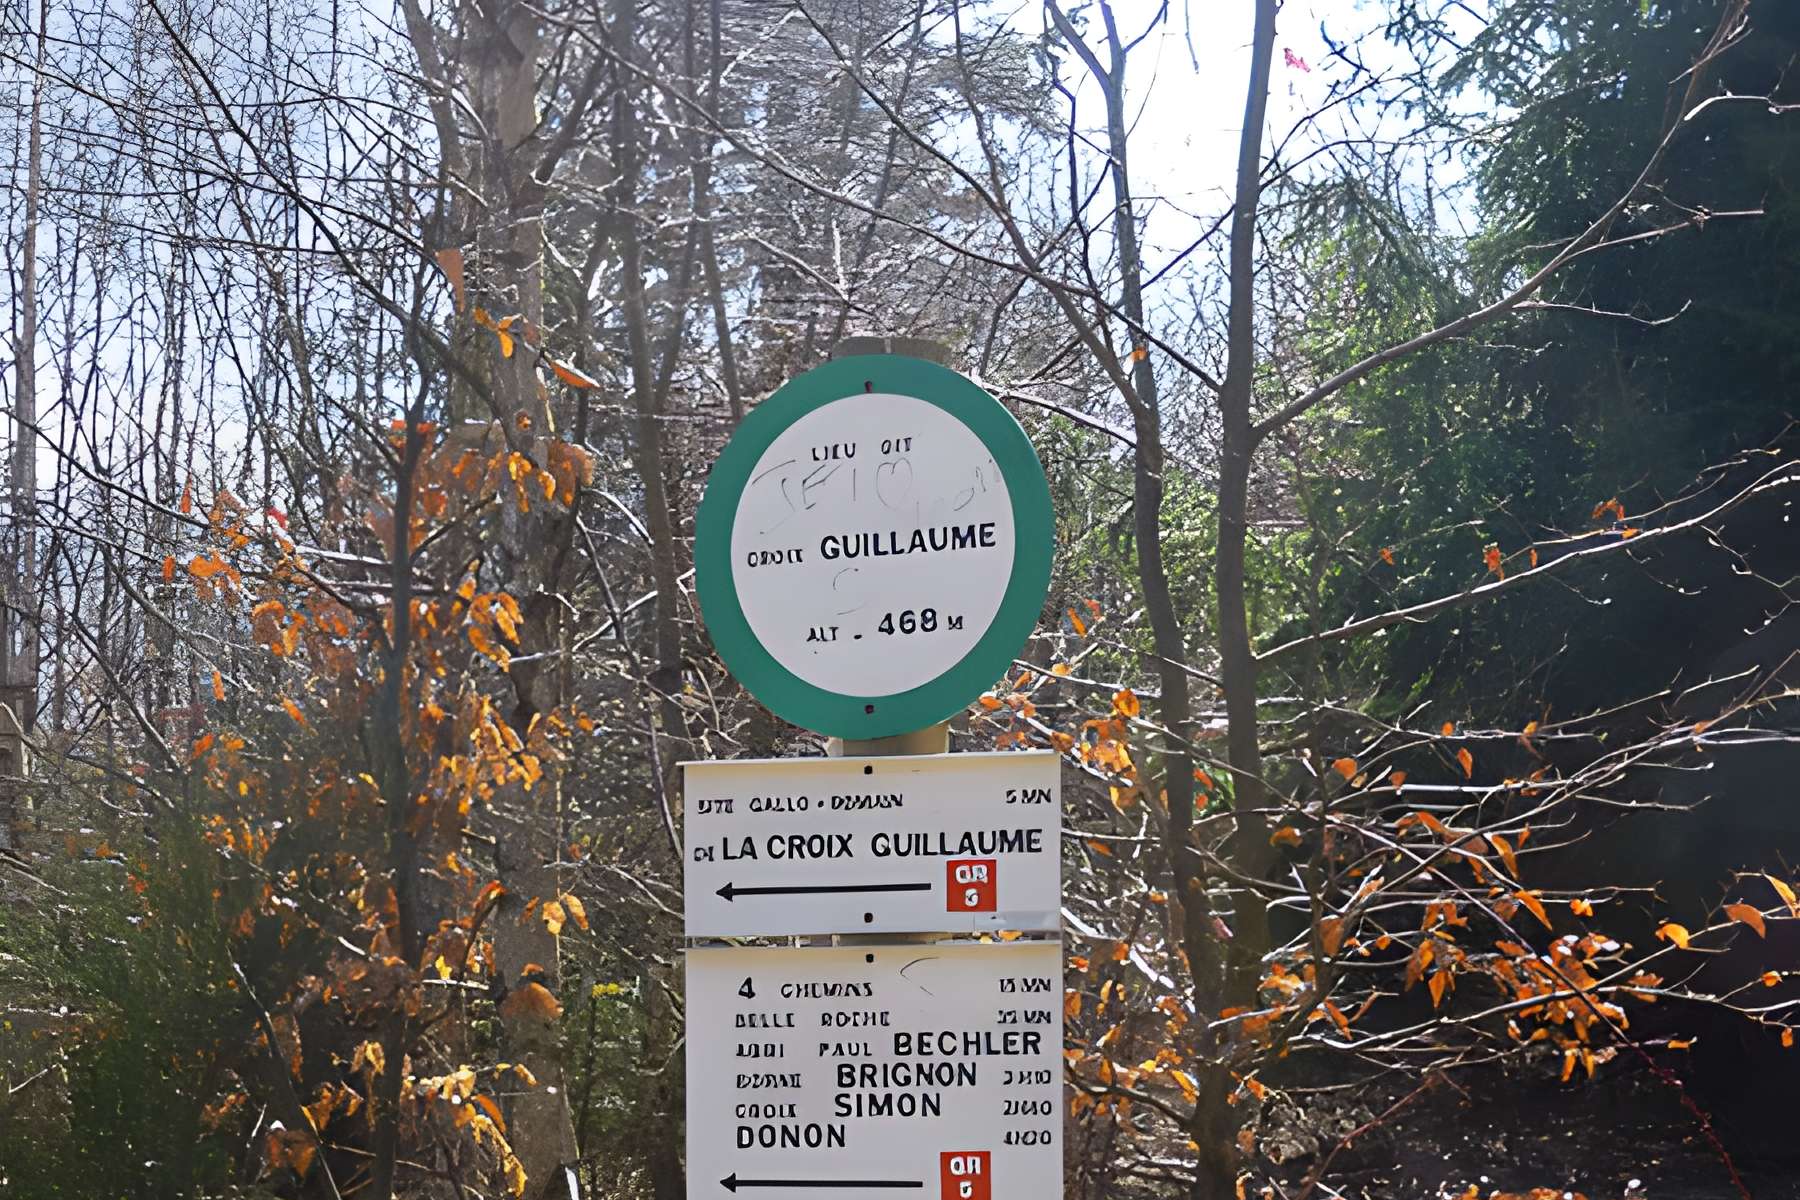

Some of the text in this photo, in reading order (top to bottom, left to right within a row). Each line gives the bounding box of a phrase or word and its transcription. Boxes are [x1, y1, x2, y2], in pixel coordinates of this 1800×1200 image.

[821, 522, 996, 559] GUILLAUME
[878, 608, 938, 635] 468
[722, 836, 757, 860] LA
[767, 833, 854, 859] CROIX
[871, 829, 1043, 857] GUILLAUME
[738, 977, 756, 999] 4
[819, 1042, 873, 1057] PAUL
[894, 1031, 1042, 1056] BECHLER
[838, 1062, 977, 1088] BRIGNON
[835, 1093, 941, 1117] SIMON
[737, 1124, 846, 1149] DONON
